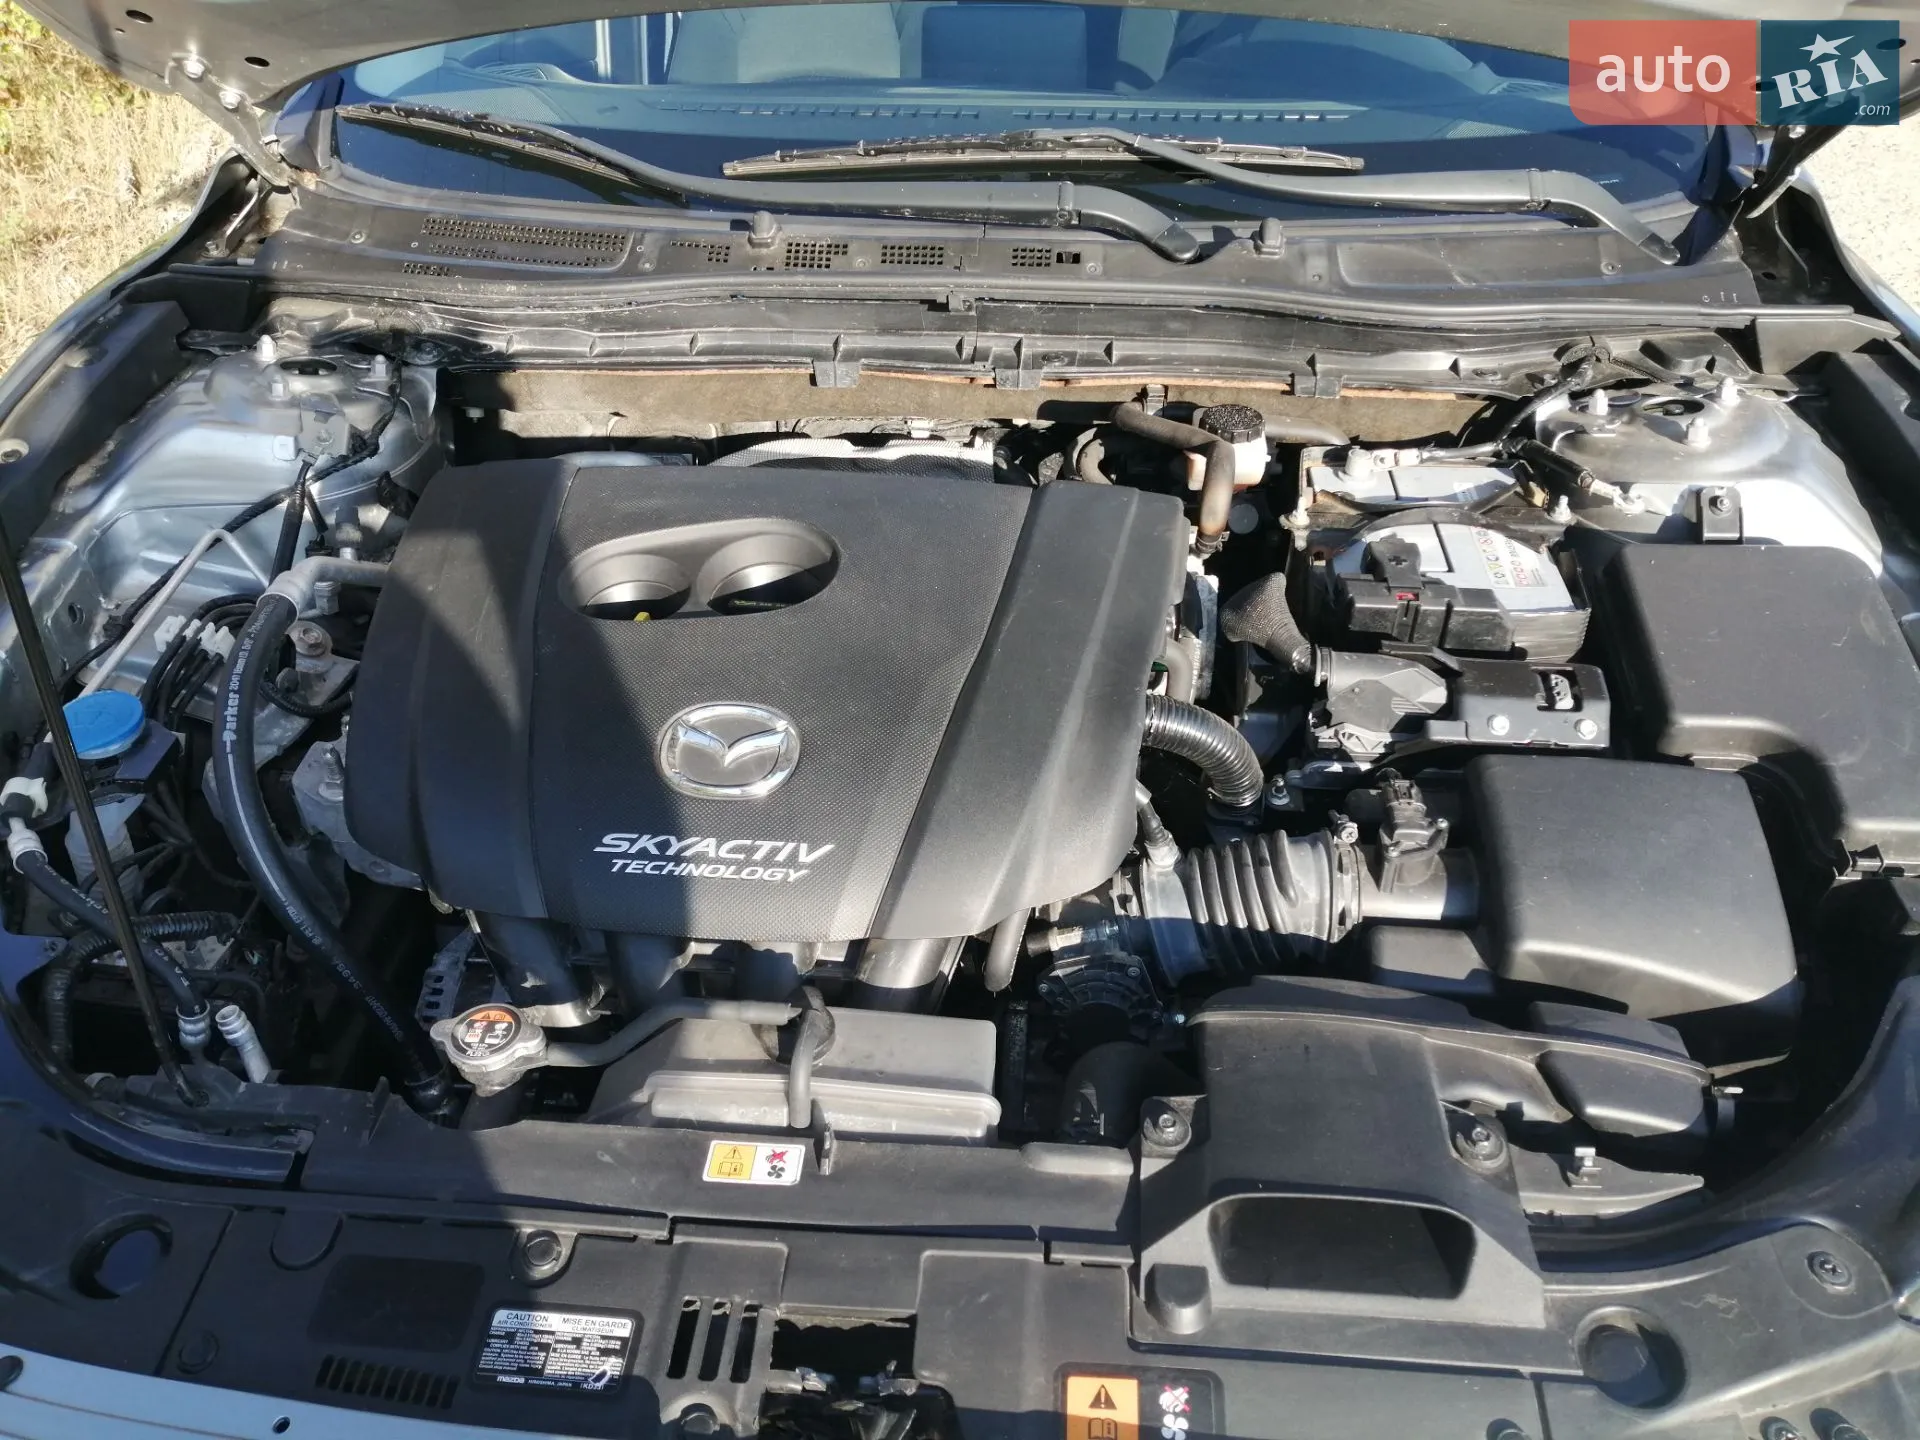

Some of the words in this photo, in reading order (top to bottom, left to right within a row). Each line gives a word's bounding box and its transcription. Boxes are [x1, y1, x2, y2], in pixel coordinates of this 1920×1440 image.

[222, 691, 240, 742] Parker
[592, 832, 836, 864] SKYACTIV
[610, 858, 811, 882] TECHNOLOGY
[506, 1312, 550, 1322] CAUTION
[509, 1320, 553, 1328] CONDITIONER
[561, 1317, 584, 1326] MISE
[585, 1319, 599, 1327] EN
[598, 1320, 630, 1329] GARDE
[571, 1326, 615, 1334] CLIMATISEUR
[496, 1375, 525, 1384] mazda
